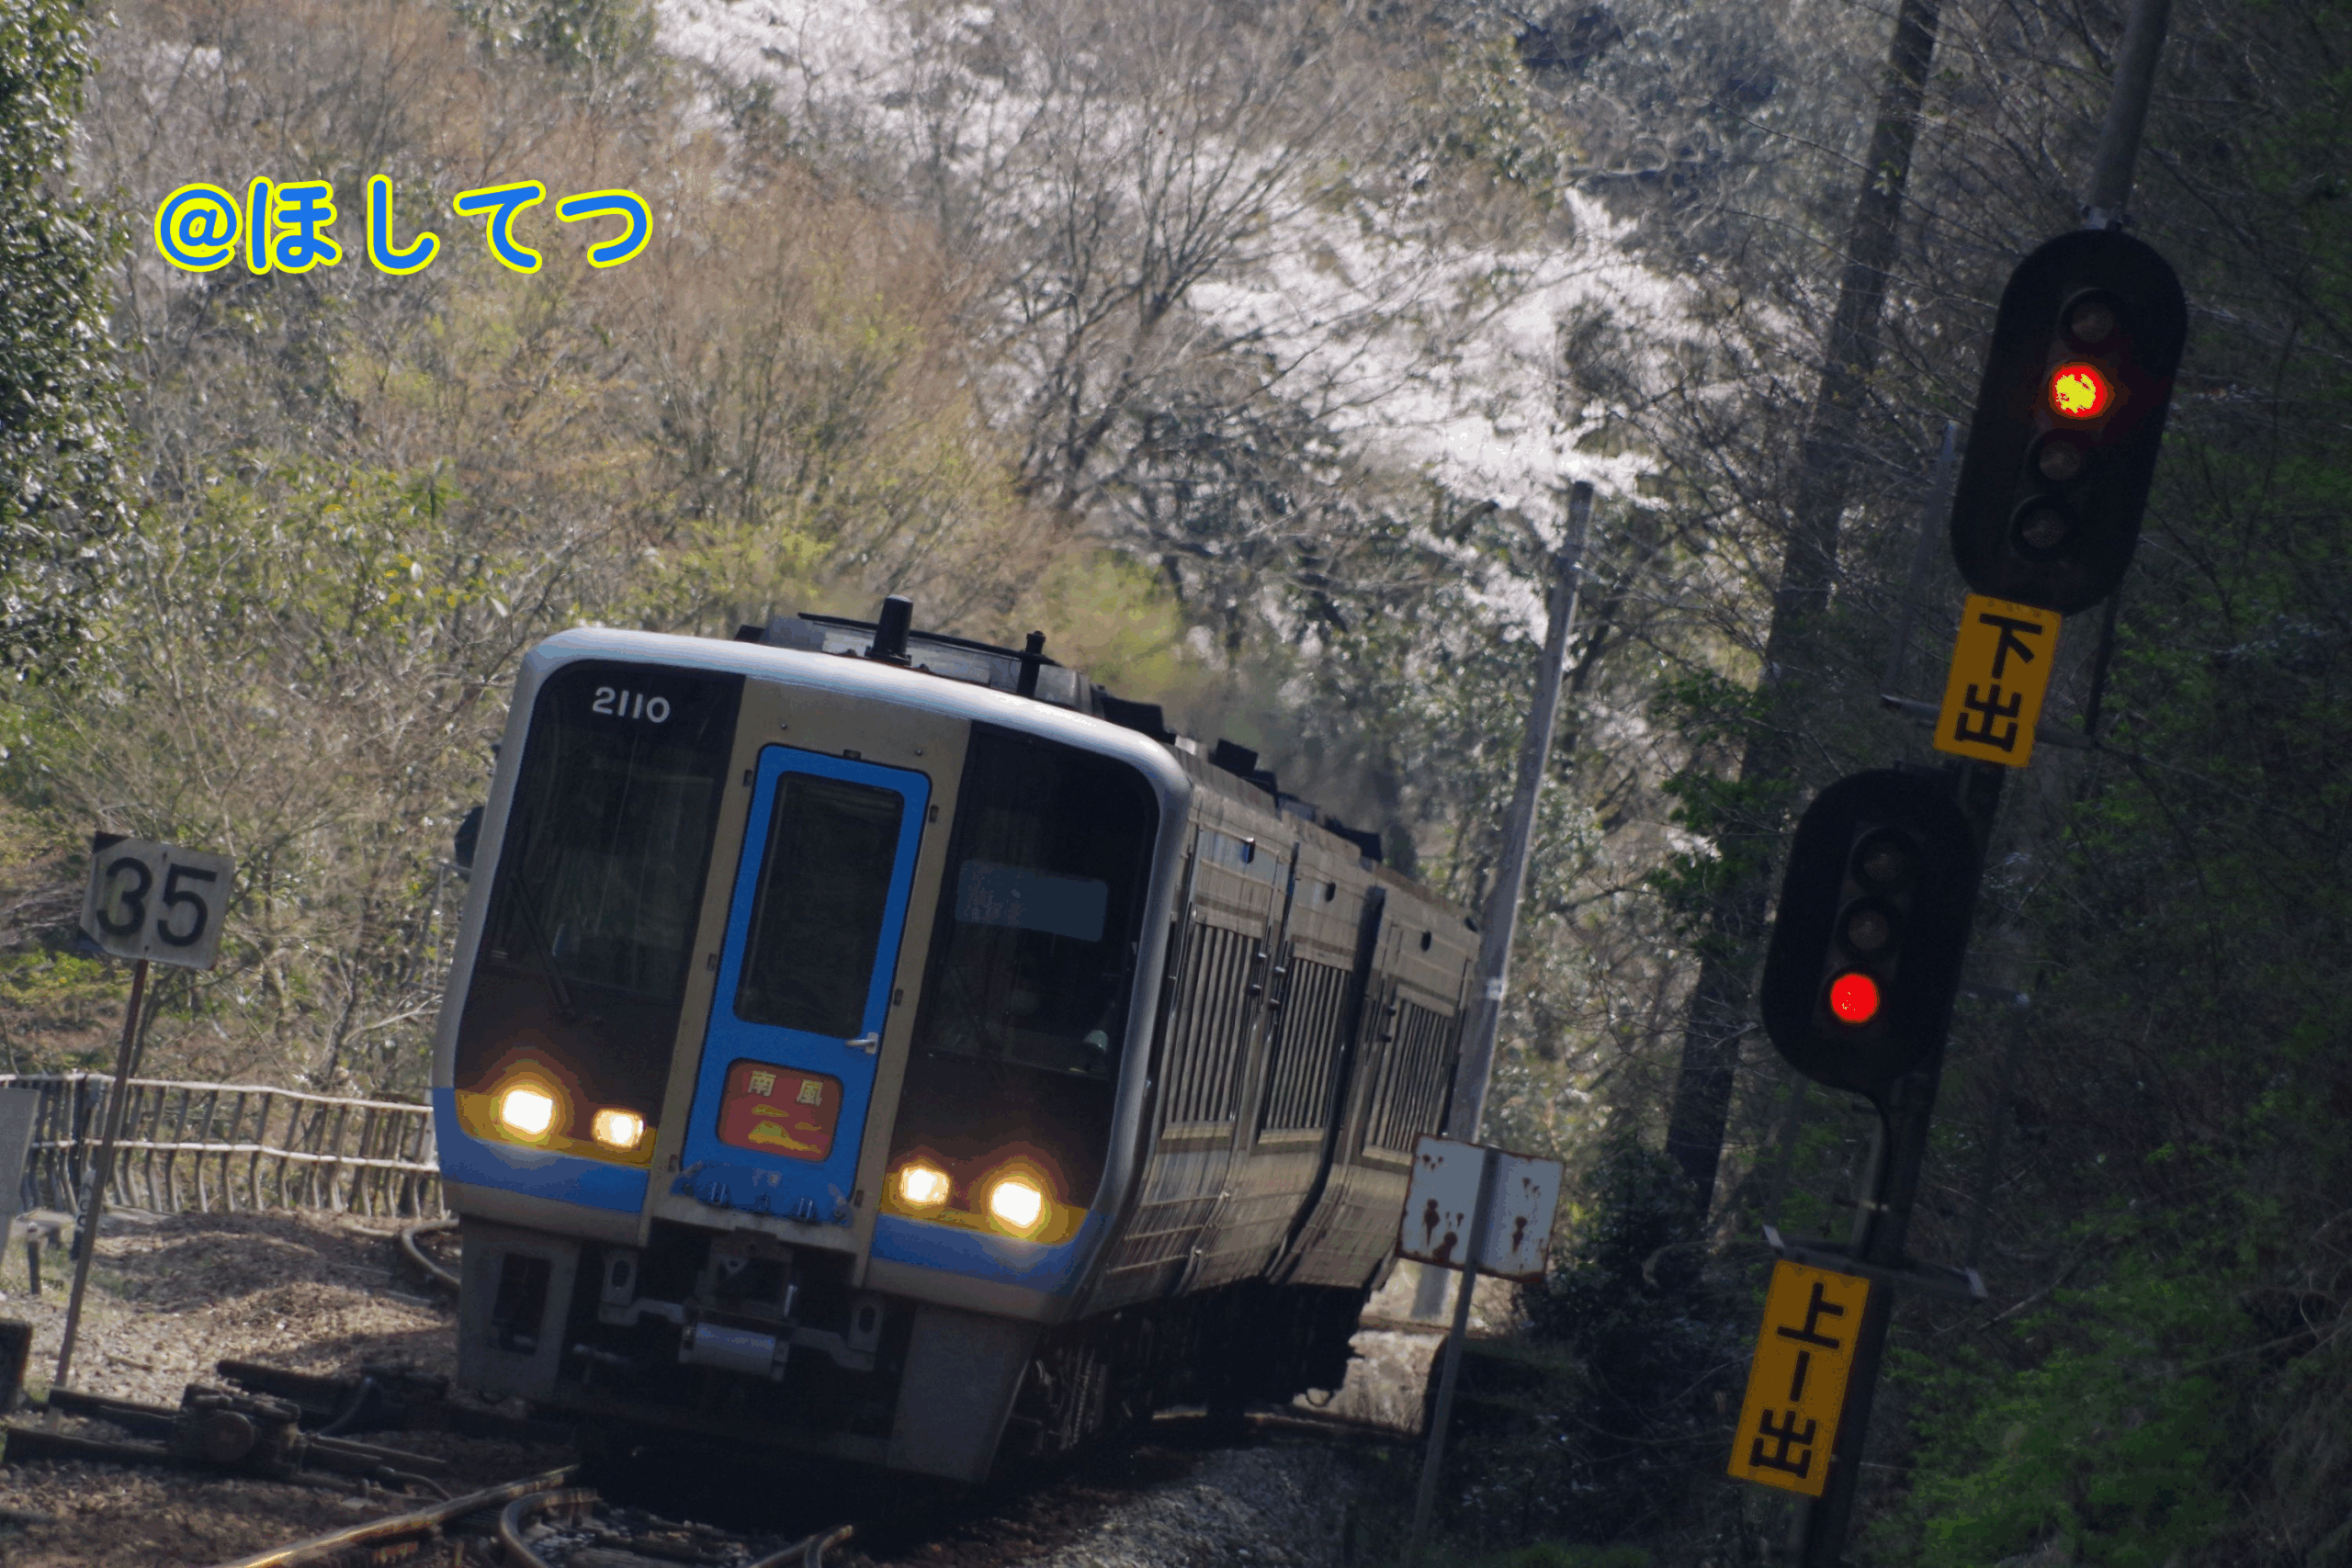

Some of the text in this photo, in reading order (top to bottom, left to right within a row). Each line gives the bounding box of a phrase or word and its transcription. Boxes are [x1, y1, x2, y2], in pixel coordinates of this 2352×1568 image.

[592, 686, 671, 723] 2110
[1954, 613, 2042, 752] 下出
[96, 856, 218, 947] 35
